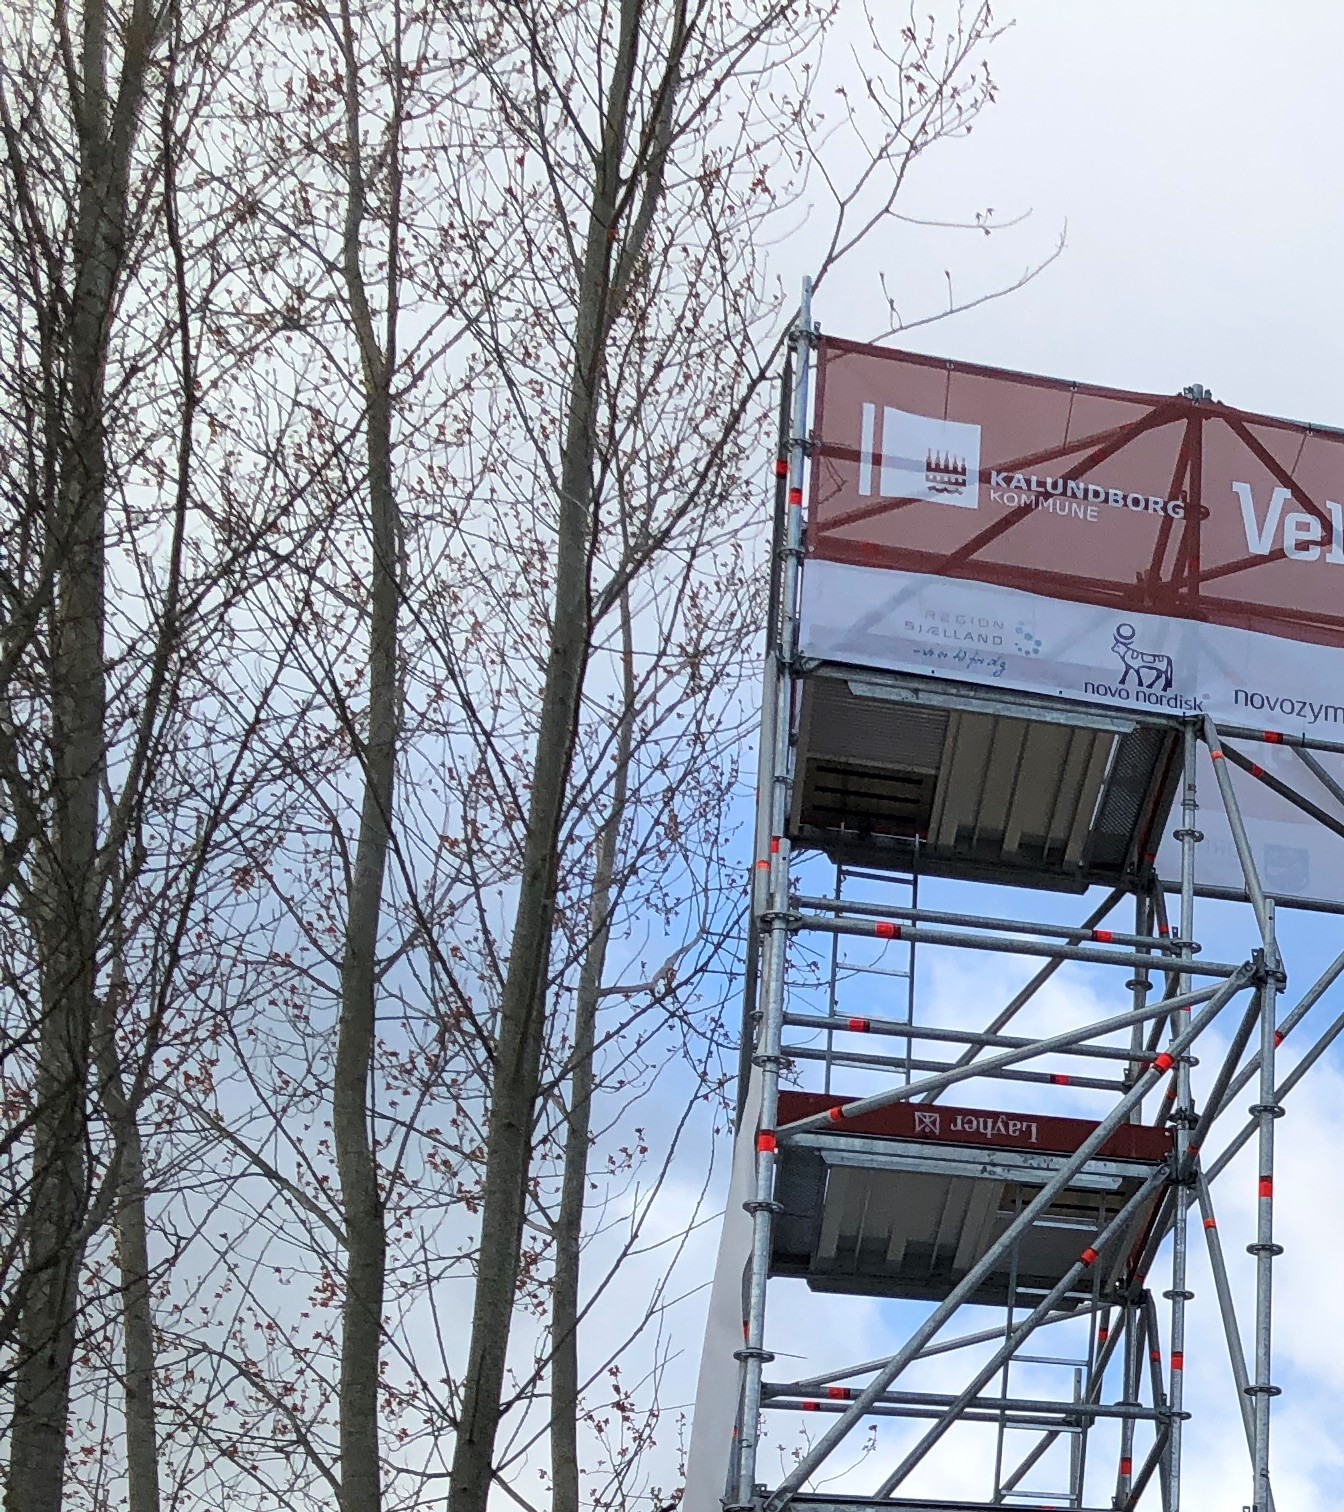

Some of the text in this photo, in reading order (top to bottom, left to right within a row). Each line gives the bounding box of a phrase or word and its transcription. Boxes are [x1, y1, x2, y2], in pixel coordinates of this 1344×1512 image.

[990, 470, 1186, 520] KALUNDBORG
[990, 488, 1100, 523] KOMMUNE
[925, 610, 1005, 630] REGION
[1083, 680, 1206, 713] novo nordisk
[949, 1114, 1040, 1144] Layher
